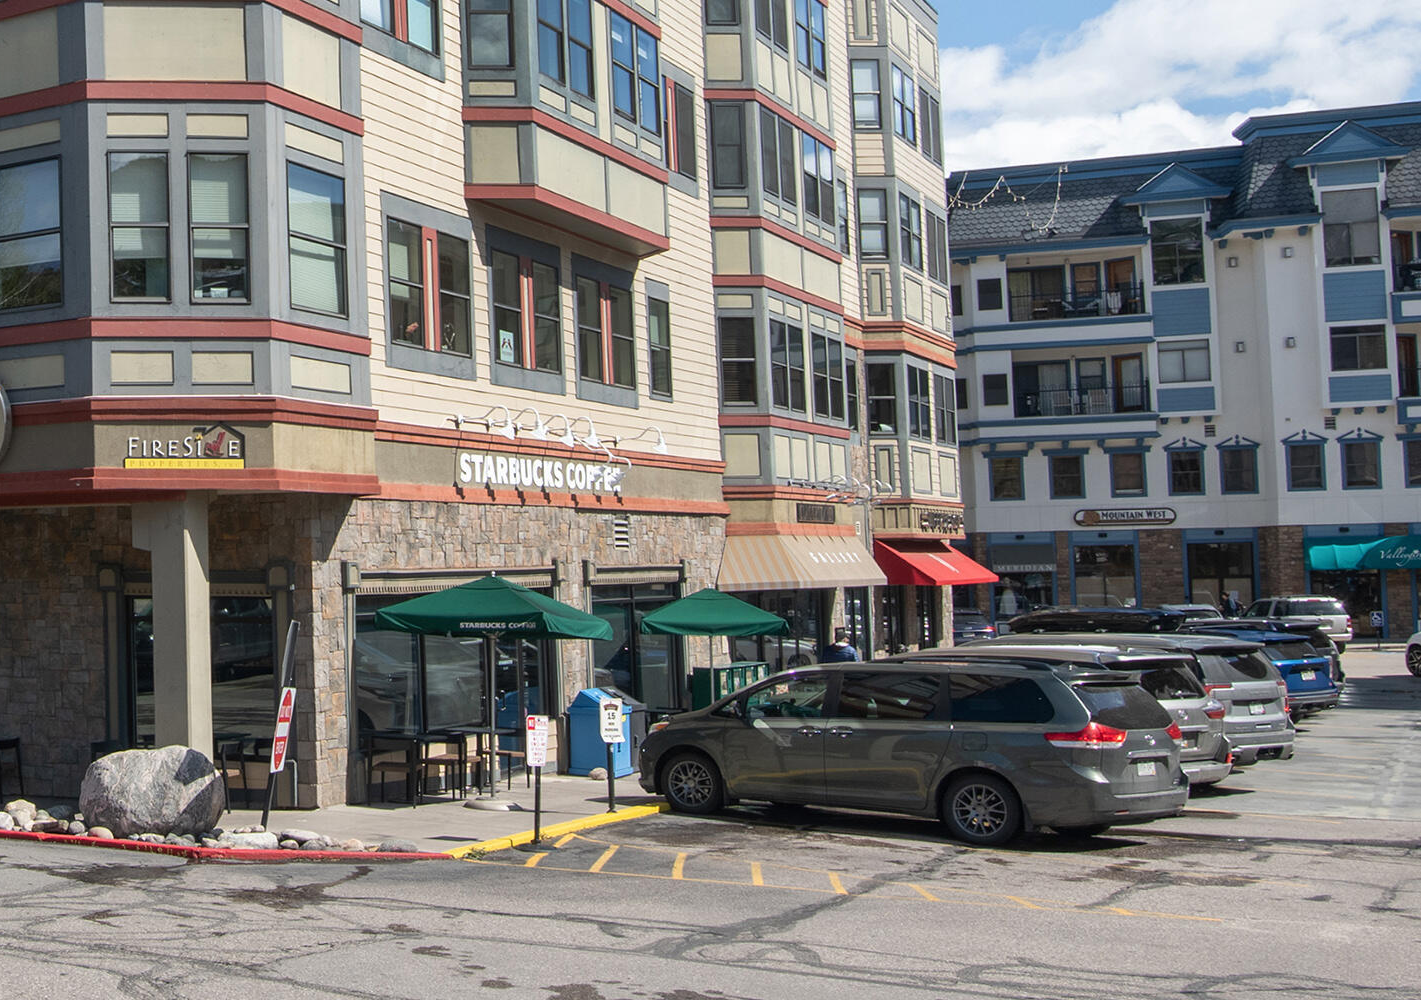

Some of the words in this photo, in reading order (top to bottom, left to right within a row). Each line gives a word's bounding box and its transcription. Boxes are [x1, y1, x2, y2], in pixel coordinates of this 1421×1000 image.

[128, 434, 240, 458] FIRESIE
[460, 453, 564, 488] STARBUCKS
[1101, 511, 1144, 520] MOUNTAIN
[1146, 510, 1166, 518] WEST
[809, 552, 861, 563] GALLERY
[607, 712, 616, 720] 15
